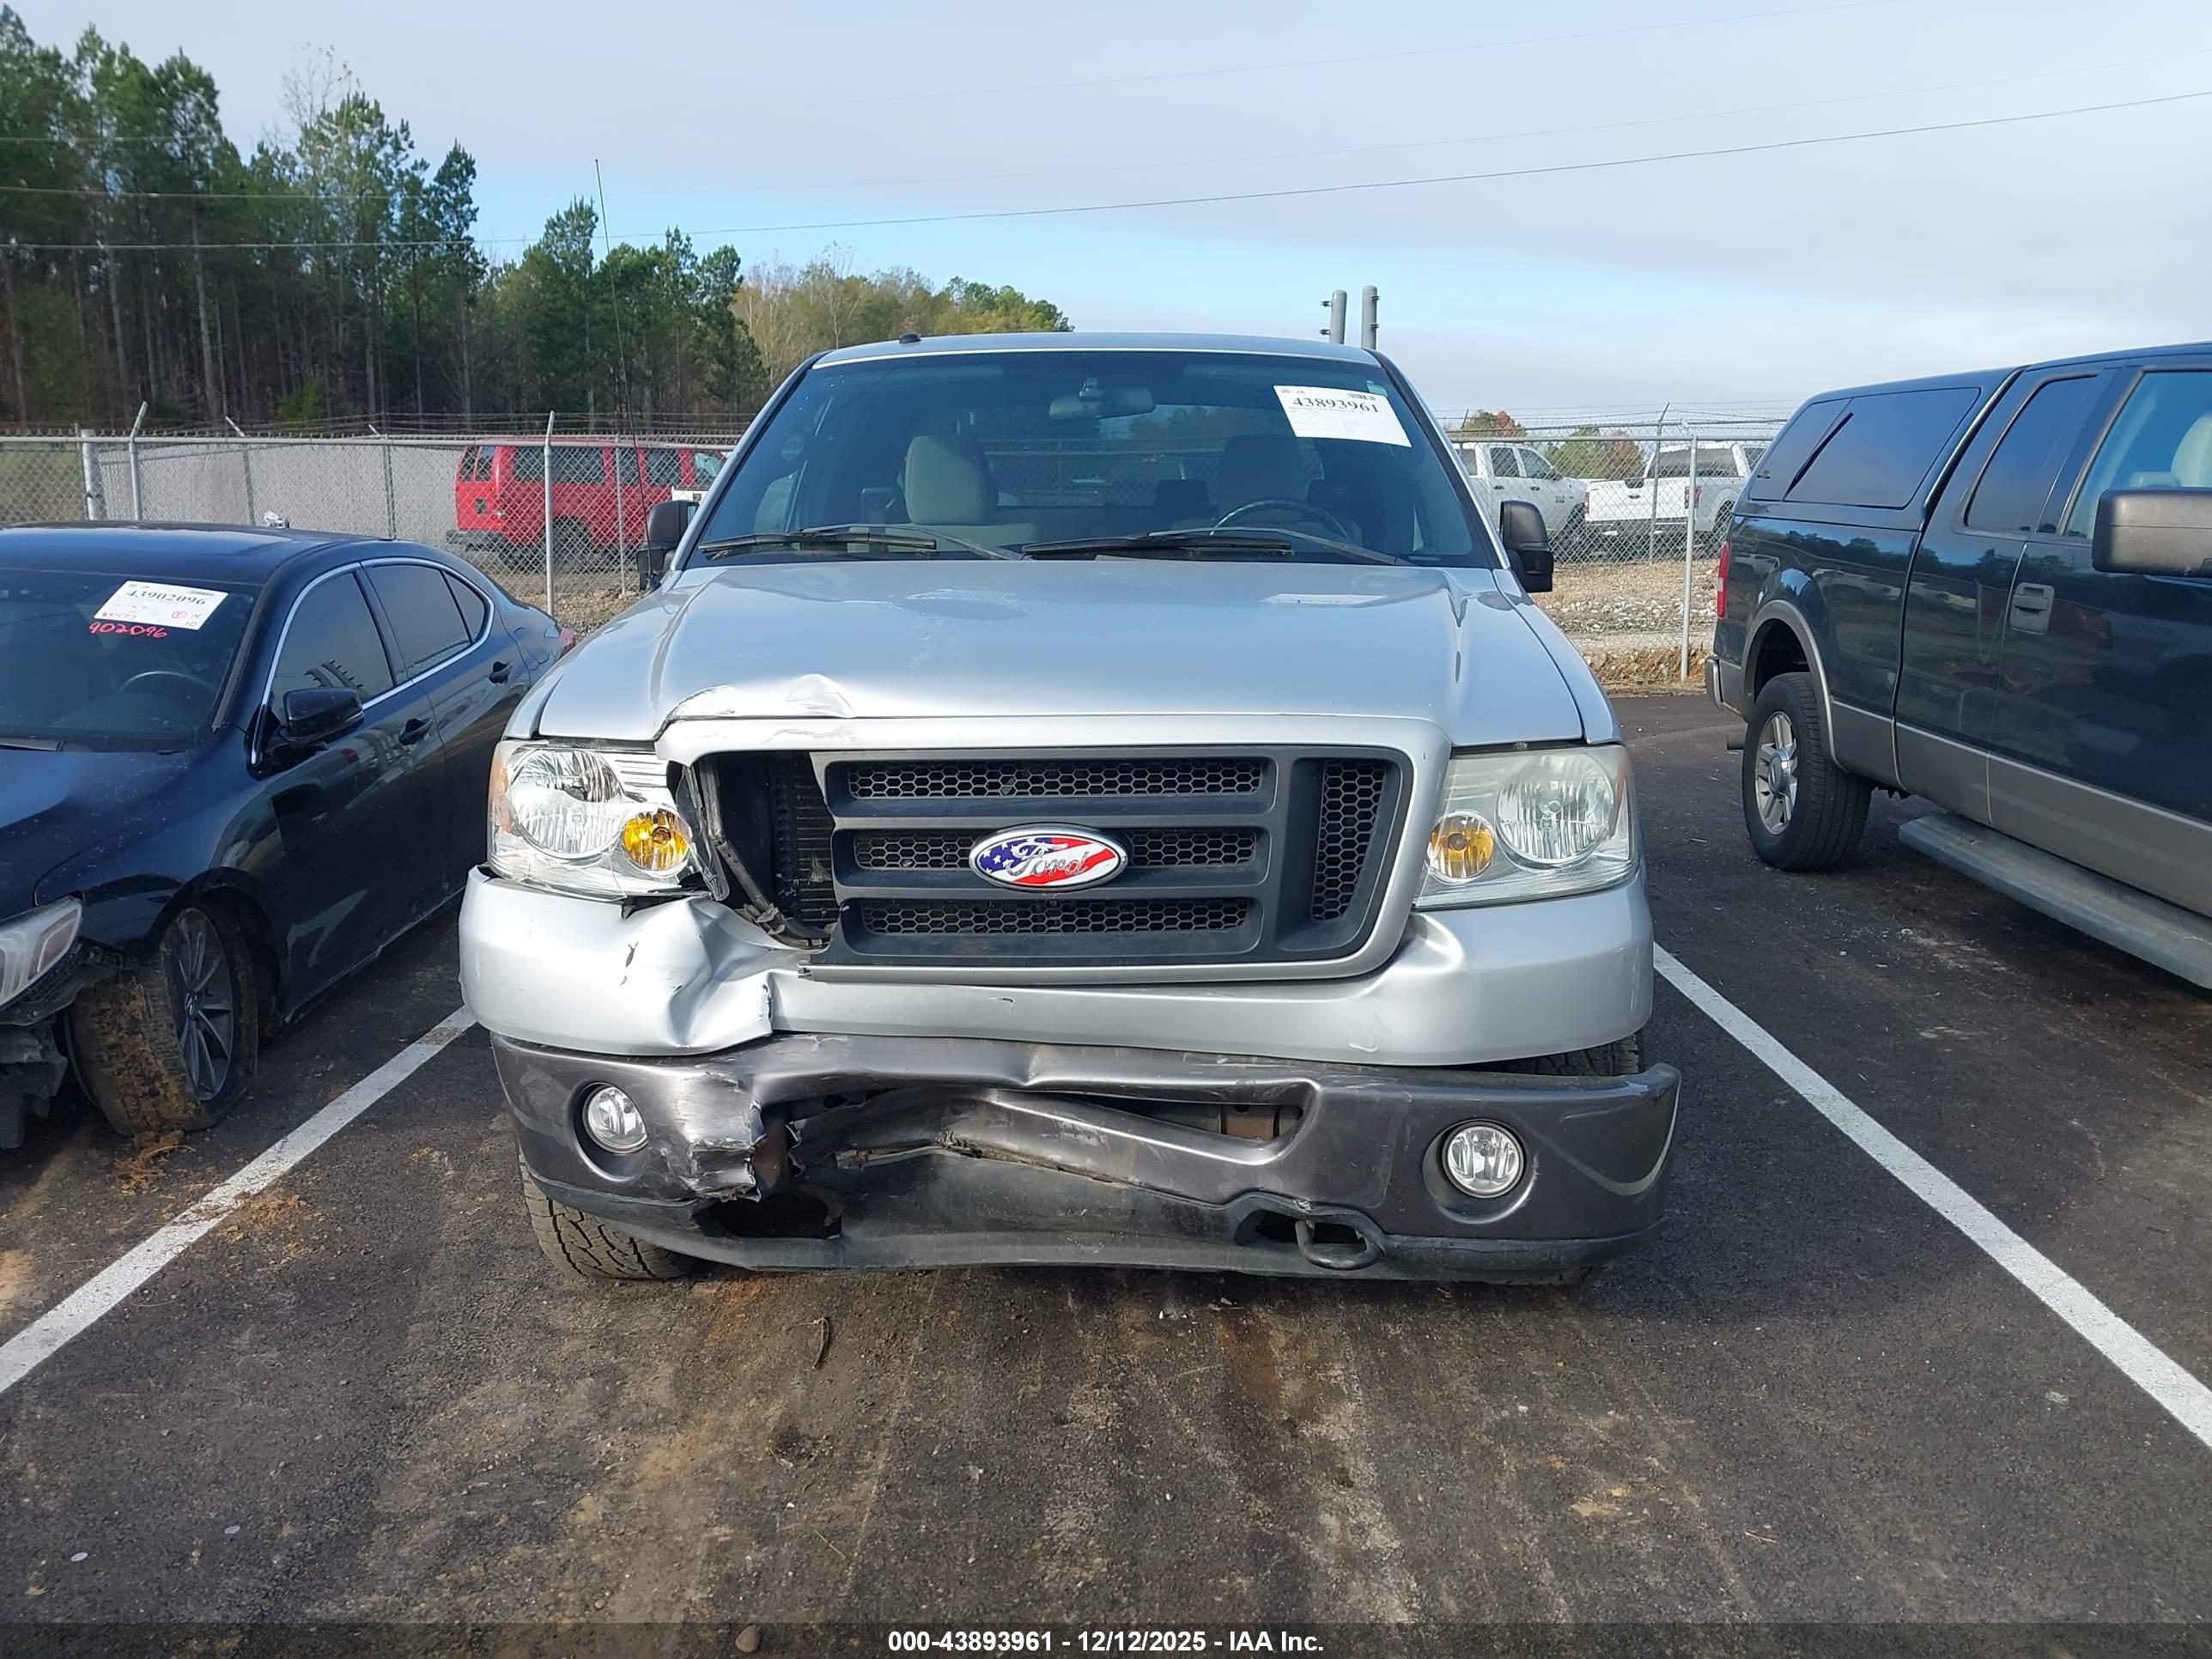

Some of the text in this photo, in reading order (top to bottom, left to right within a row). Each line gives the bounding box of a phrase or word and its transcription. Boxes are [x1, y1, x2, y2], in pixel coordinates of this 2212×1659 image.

[1292, 397, 1380, 413] 43893961
[126, 590, 206, 605] 43902096
[88, 622, 167, 638] 902096
[1005, 842, 1090, 877] Ford
